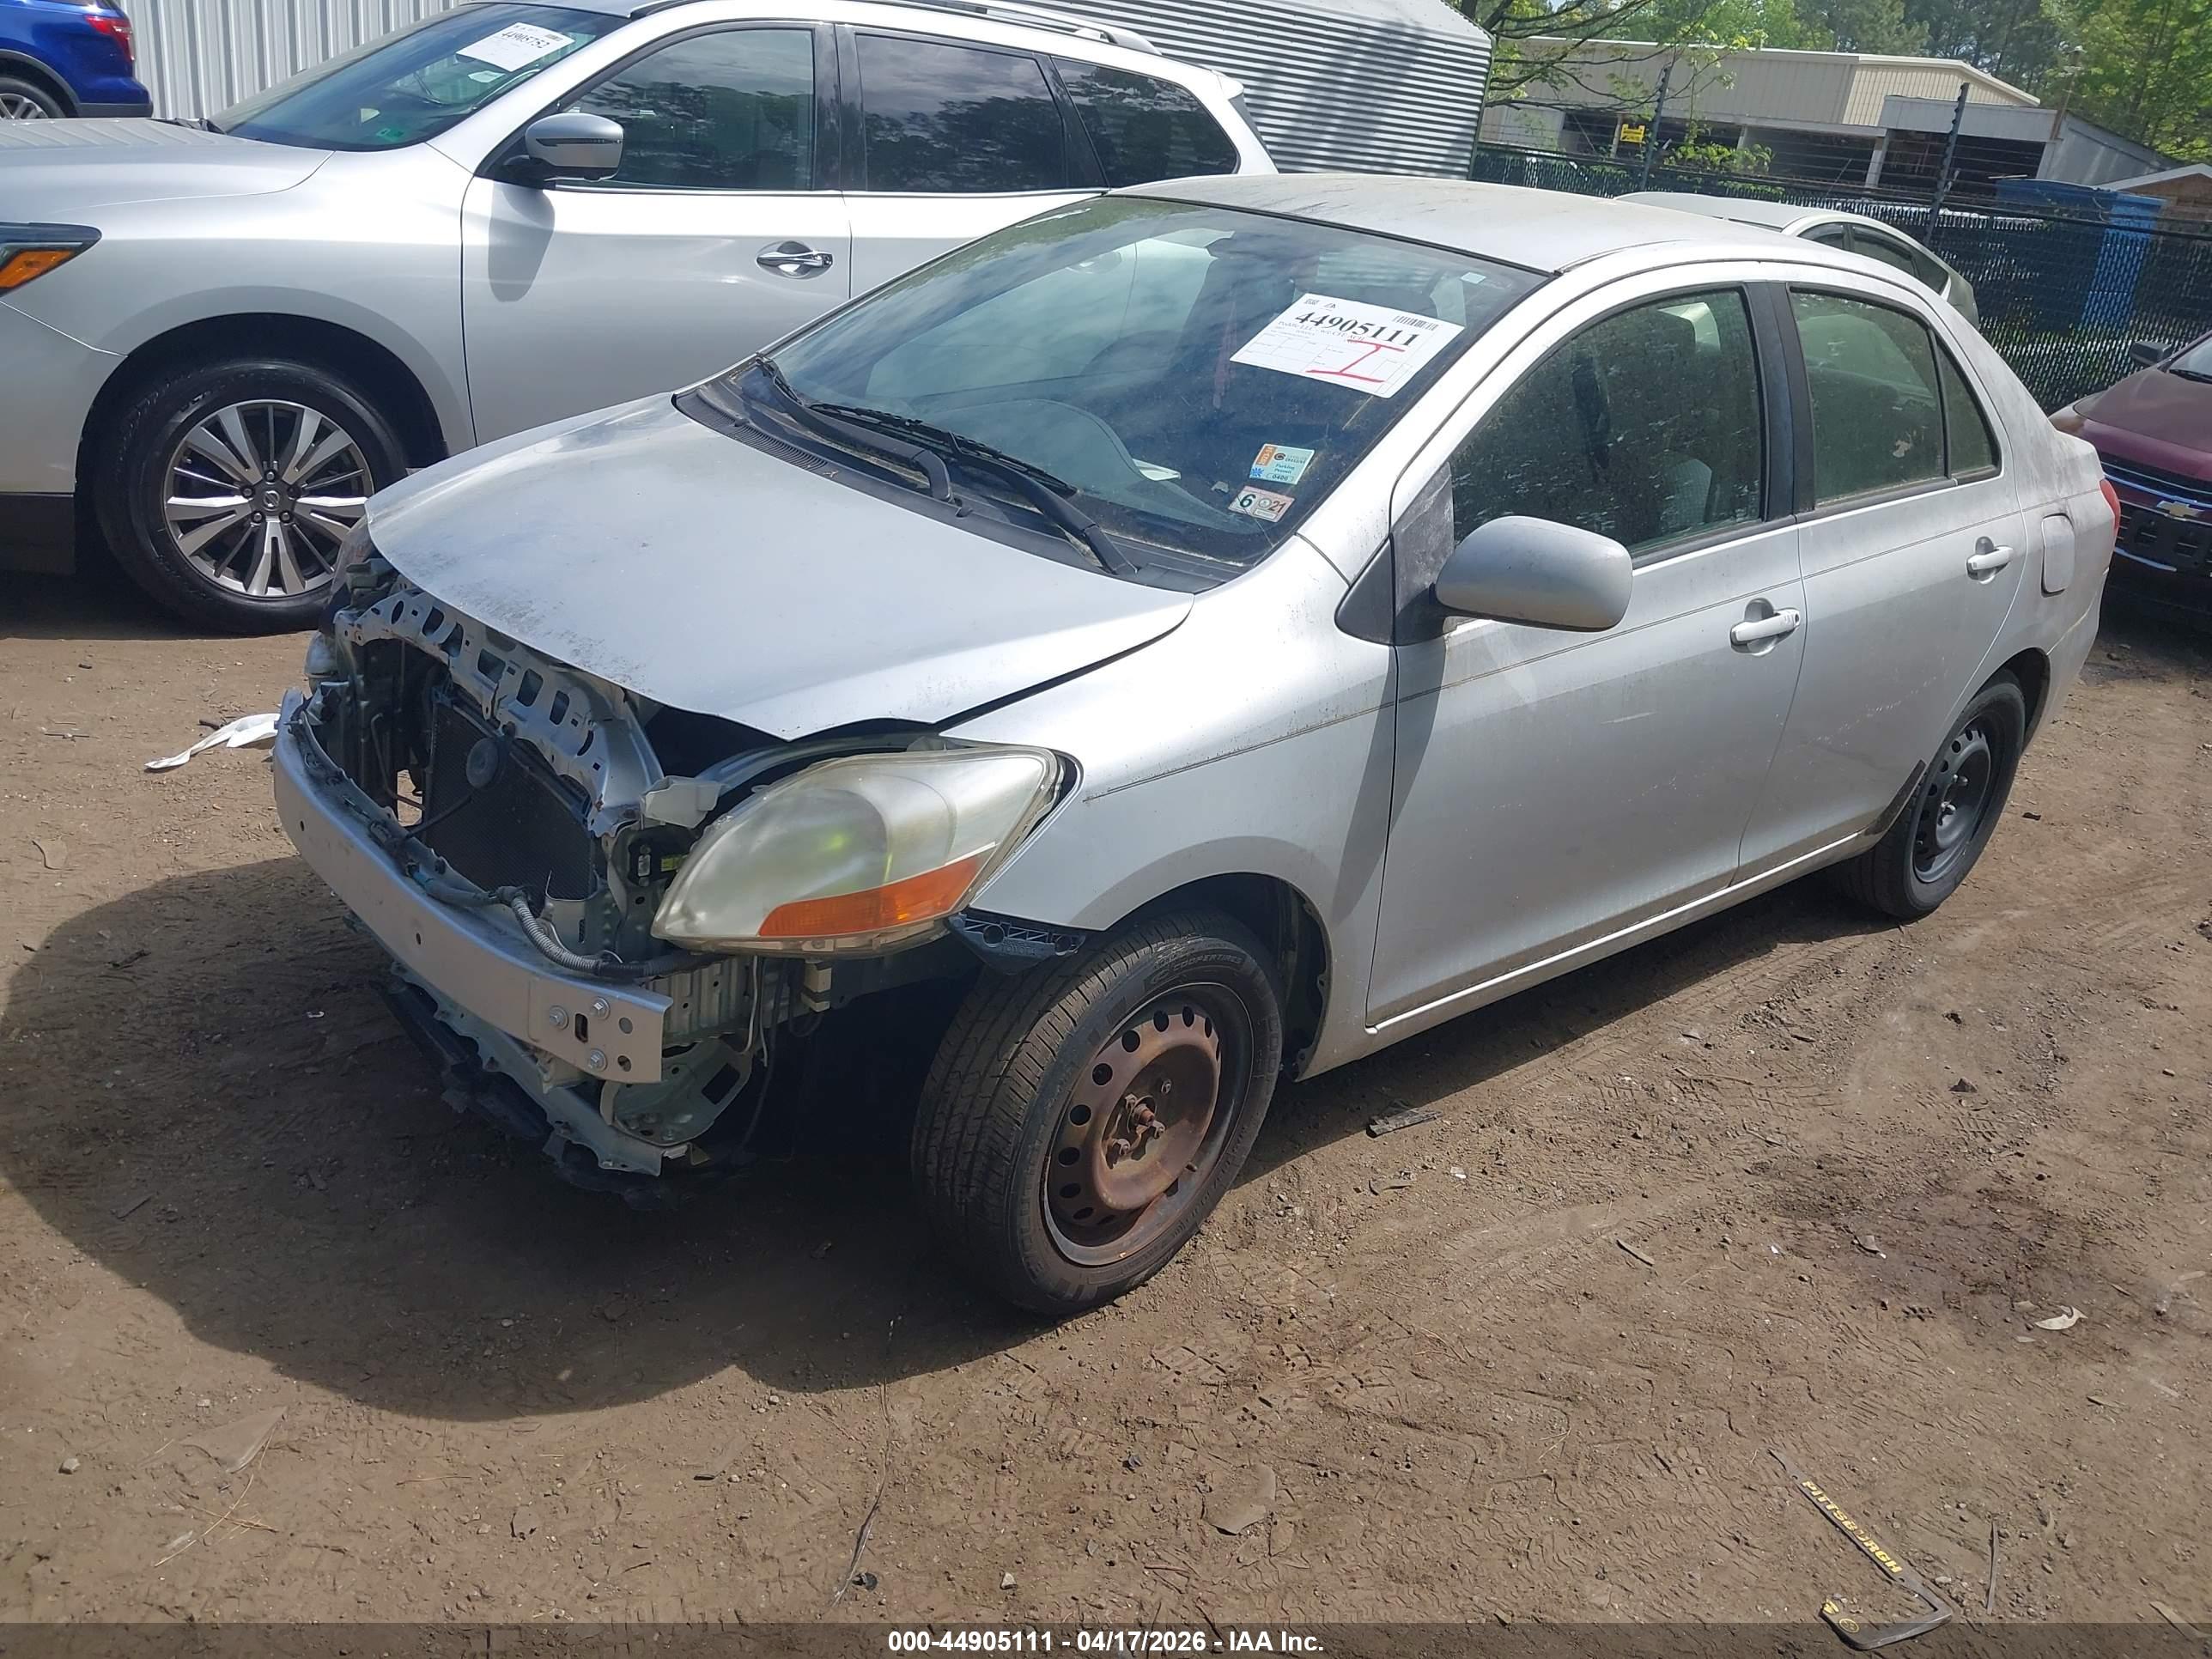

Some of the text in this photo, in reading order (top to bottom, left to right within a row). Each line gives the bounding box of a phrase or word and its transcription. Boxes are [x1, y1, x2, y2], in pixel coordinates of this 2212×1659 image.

[1295, 311, 1420, 347] 44905111
[1239, 493, 1286, 514] 6 21
[1801, 1480, 1903, 1574] PITTSBURGH
